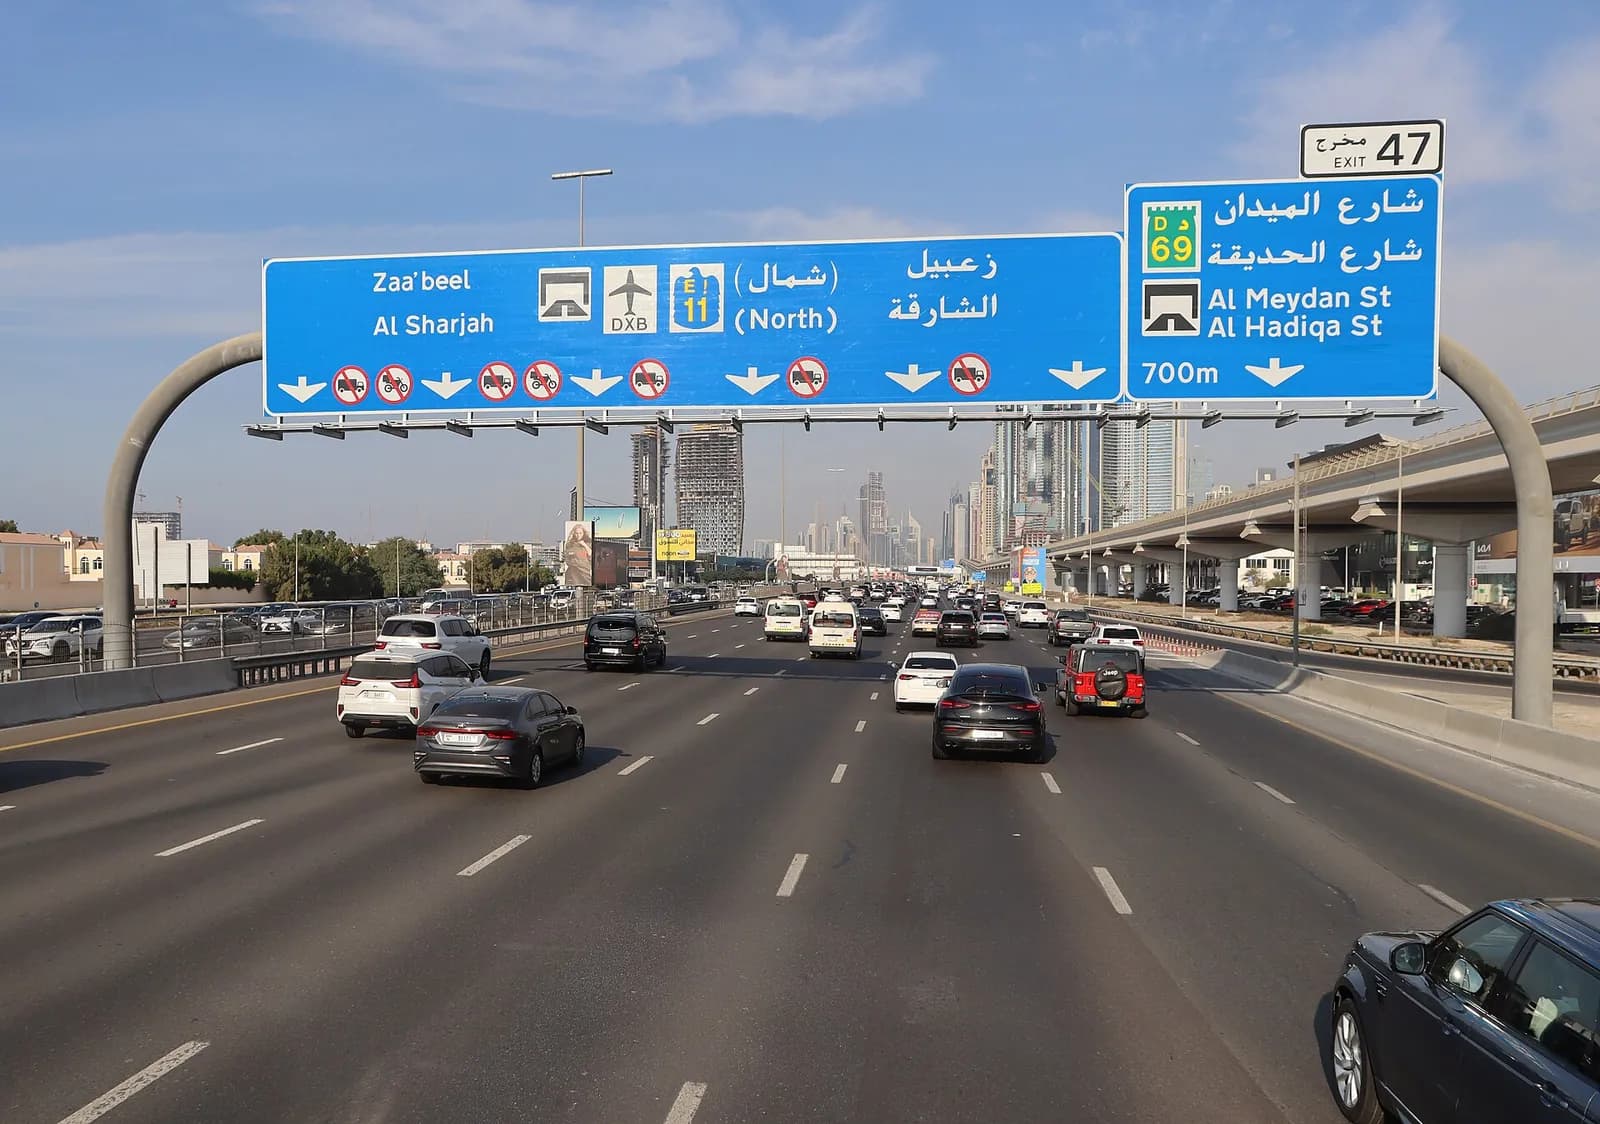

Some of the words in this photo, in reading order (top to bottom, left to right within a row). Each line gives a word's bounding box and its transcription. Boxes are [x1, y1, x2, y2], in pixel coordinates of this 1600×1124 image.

[1316, 133, 1367, 152] مخرج
[1376, 131, 1431, 166] 47
[1333, 156, 1367, 168] EXIT
[1214, 189, 1320, 226] الميدان
[1337, 188, 1424, 225] شارع
[1154, 216, 1168, 232] D
[1151, 235, 1193, 262] 69
[1207, 239, 1326, 271] الحديقة
[1339, 238, 1423, 273] شارع
[906, 247, 998, 280] زعبيل
[373, 269, 471, 293] Zaa'beel
[684, 279, 695, 293] E
[734, 260, 838, 297] (شمال)
[684, 297, 707, 322] 11
[888, 293, 998, 328] الشارقة
[1207, 288, 1237, 310] Al
[1246, 286, 1350, 314] Meydan
[1359, 285, 1392, 308] St
[373, 315, 398, 336] Al
[405, 312, 494, 337] Sharjah
[611, 316, 648, 332] DXB
[734, 306, 838, 336] (North)
[1207, 316, 1236, 338] Al
[1245, 314, 1341, 343] Hadiqa
[1350, 313, 1383, 337] St
[1141, 361, 1219, 384] 700m
